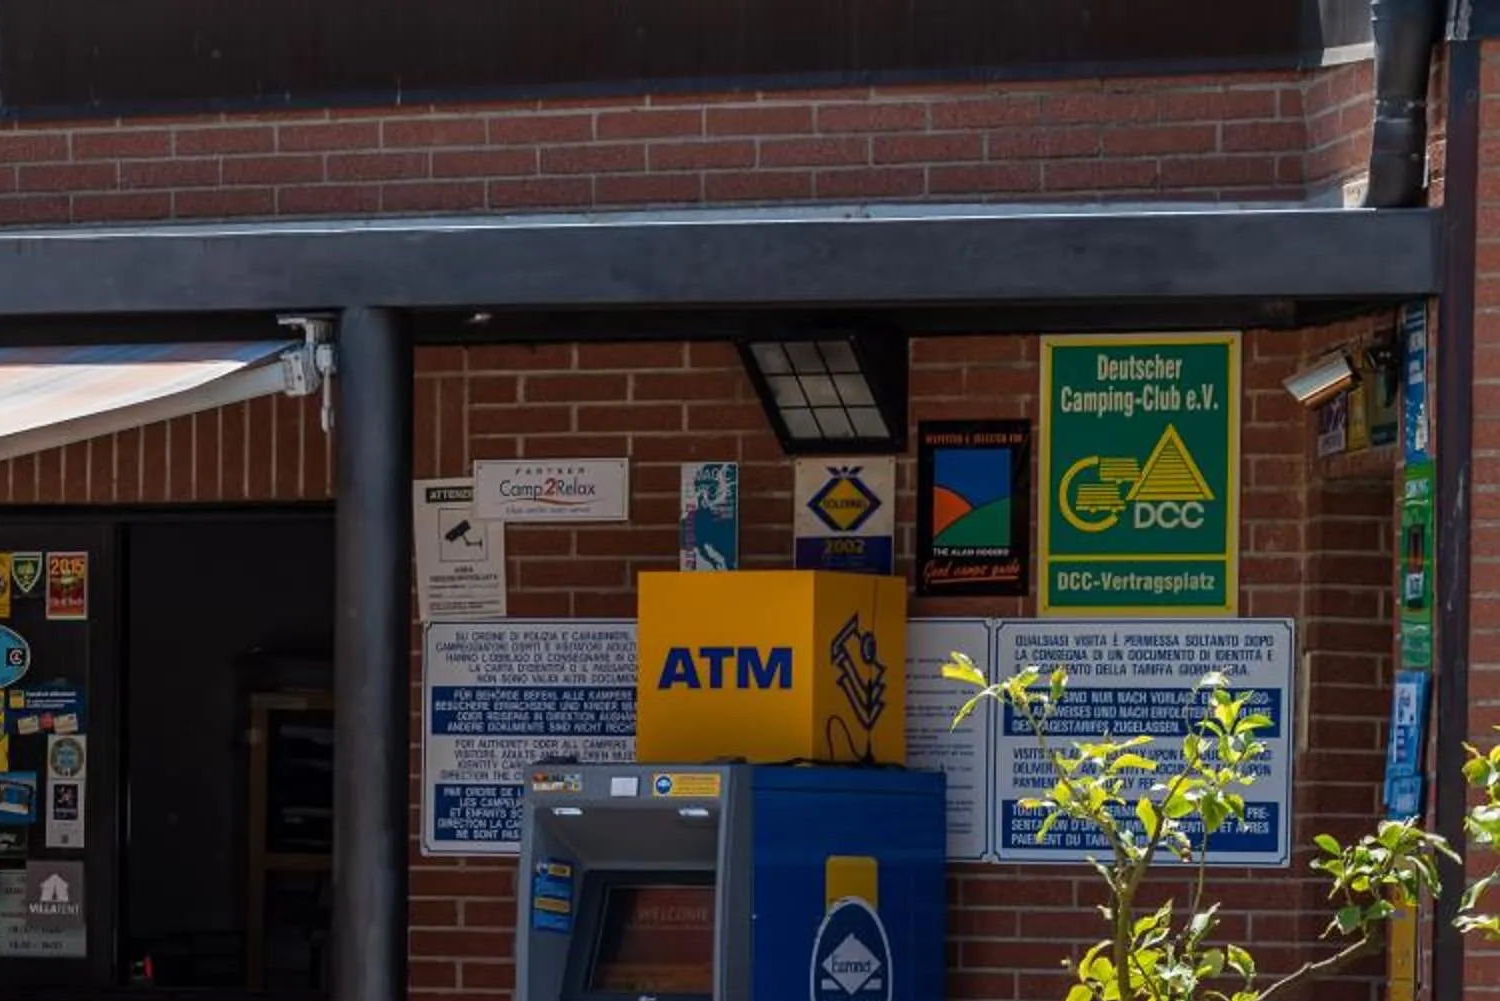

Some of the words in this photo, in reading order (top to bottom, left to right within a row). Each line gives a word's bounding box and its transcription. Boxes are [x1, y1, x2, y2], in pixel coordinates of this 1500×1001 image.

[1097, 353, 1182, 381] Deutscher
[1061, 384, 1181, 418] Camping-Club
[1186, 383, 1219, 411] e.V.
[500, 478, 595, 498] Camp2Relax
[1134, 501, 1205, 529] DCC
[51, 558, 84, 574] 2015
[1057, 571, 1215, 594] DCC-Vertragsplatz
[1124, 635, 1179, 646] PERMESSA
[1185, 635, 1239, 646] SOLTANTO
[1244, 635, 1274, 646] DOPO
[1128, 650, 1195, 661] DOCUMENTO
[658, 647, 792, 689] ATM
[1096, 664, 1127, 675] DELLA
[1131, 664, 1173, 675] TARIFFA
[1118, 691, 1147, 704] NACH
[29, 903, 80, 914] VILLATENT
